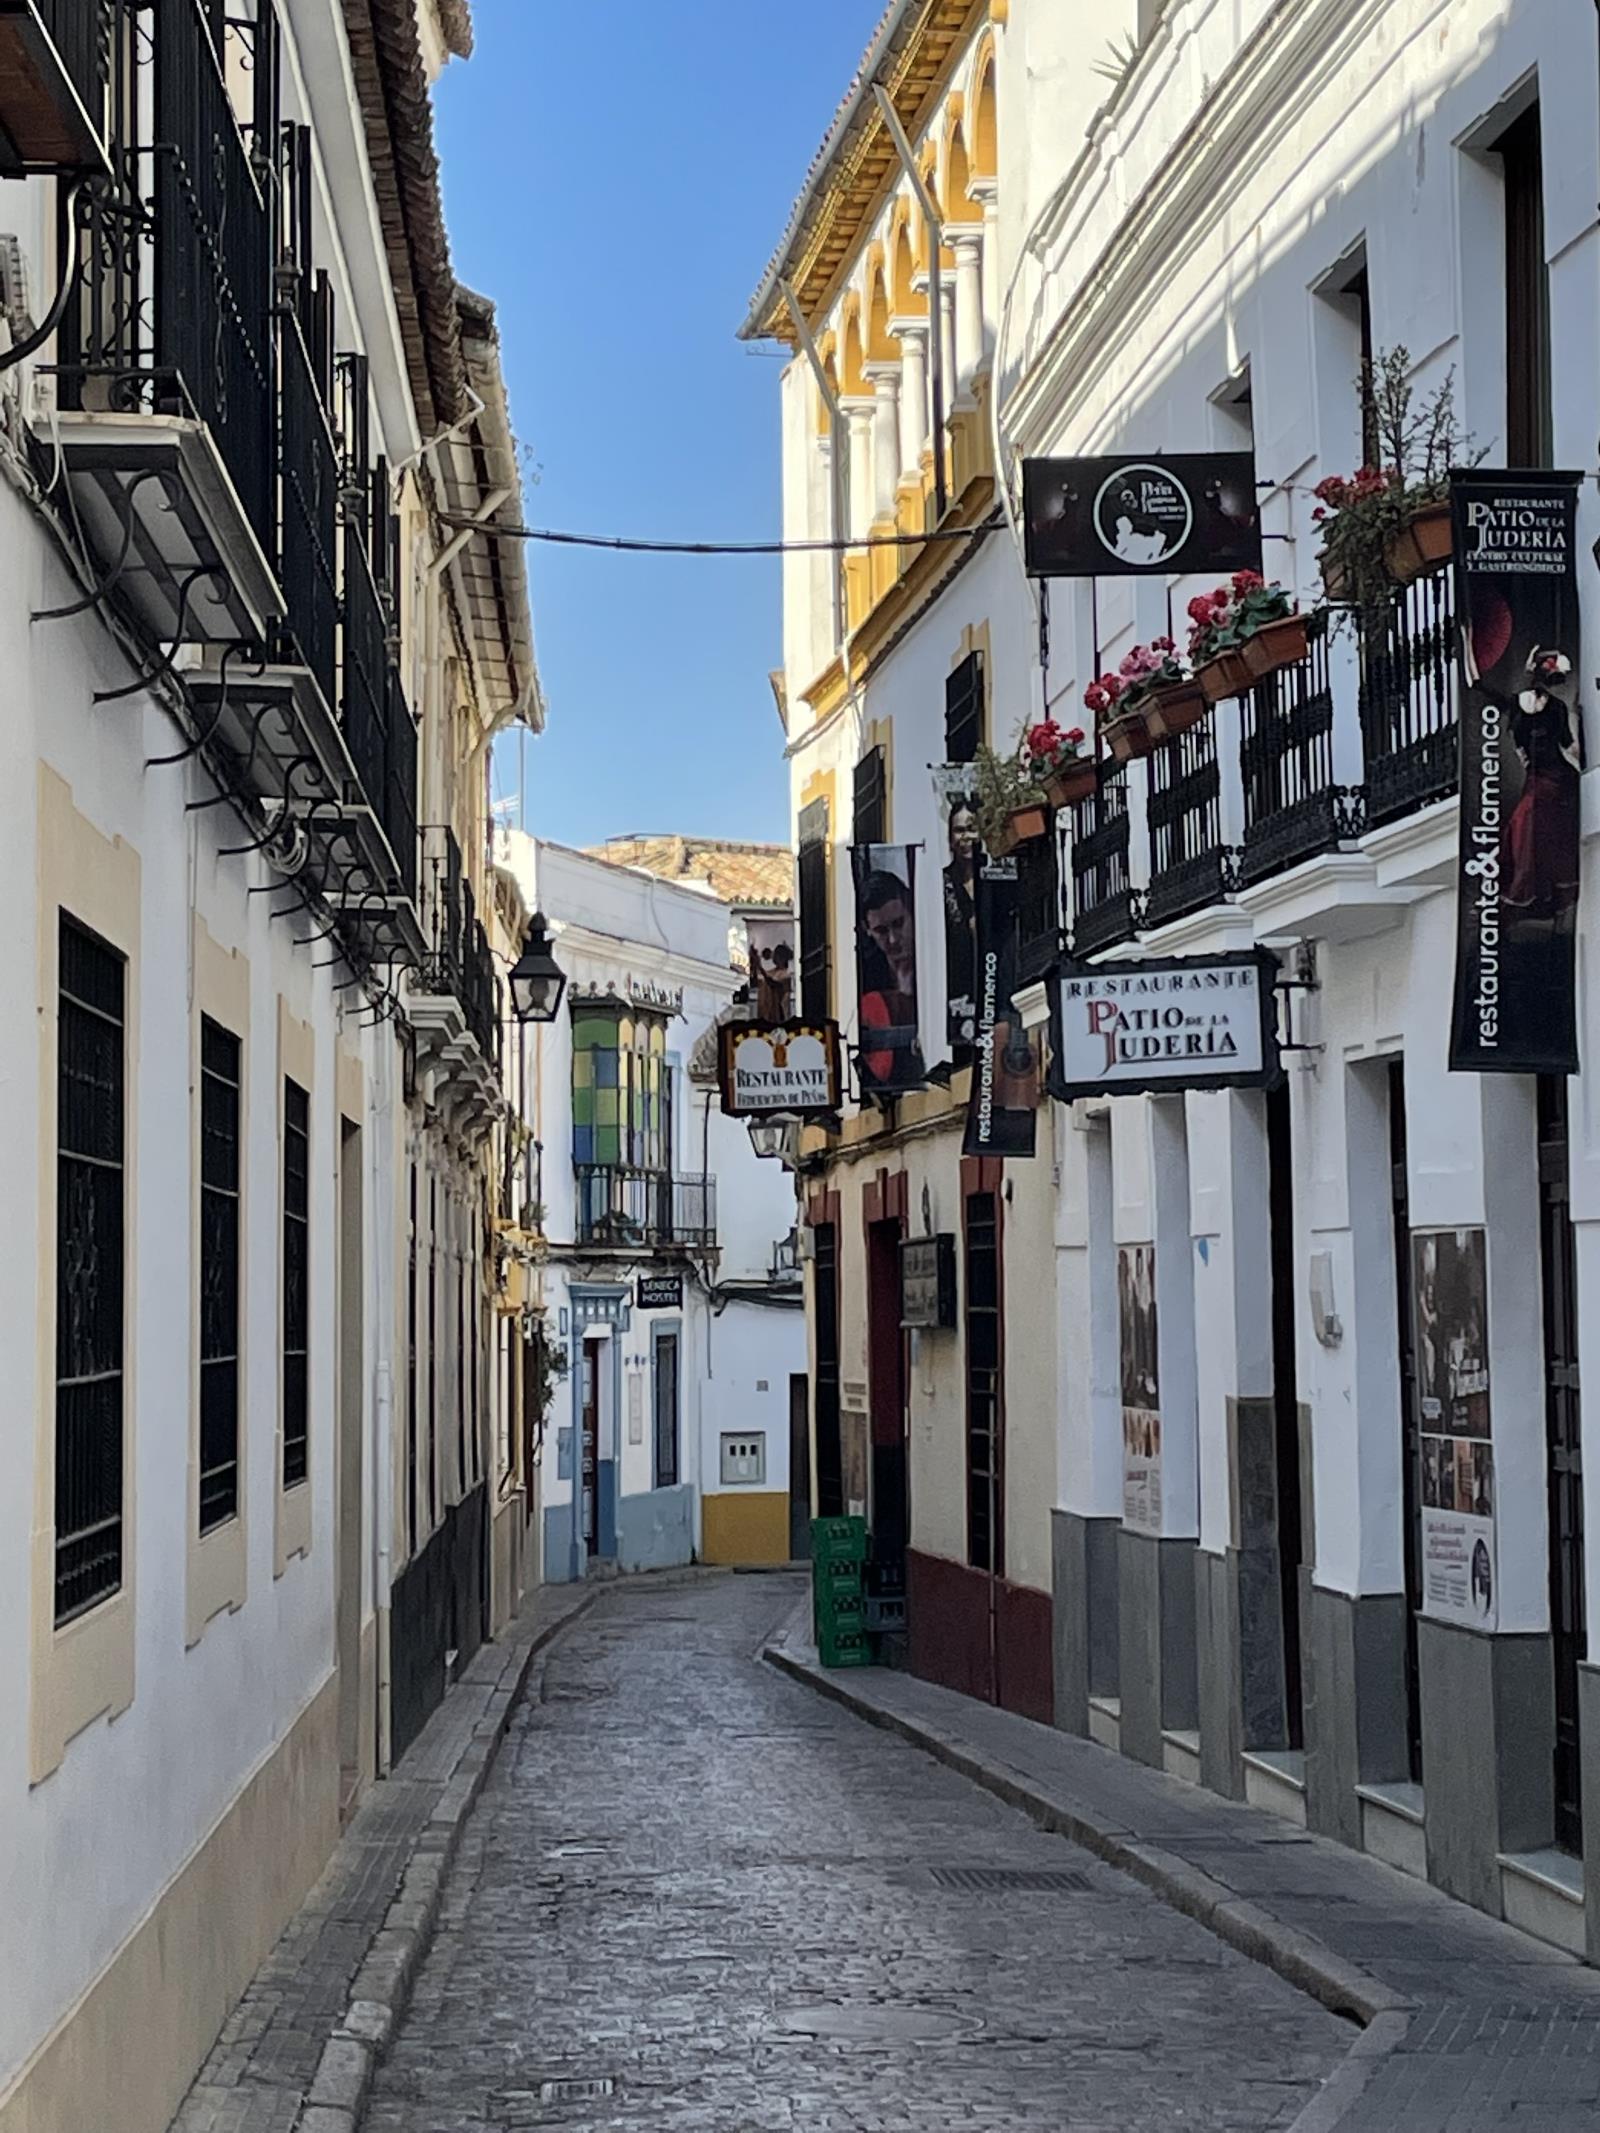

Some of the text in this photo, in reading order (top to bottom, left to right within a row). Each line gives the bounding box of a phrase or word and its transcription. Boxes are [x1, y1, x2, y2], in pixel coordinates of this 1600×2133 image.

[1467, 502, 1535, 527] PATIO
[1474, 526, 1566, 555] JUDERÍA
[1464, 704, 1500, 1047] restaurante&flamenco
[1067, 970, 1254, 999] RESTAURANTE
[1087, 1001, 1230, 1035] PATIO DE LA
[1098, 1025, 1237, 1077] JUDERÍA
[737, 1069, 827, 1088] RESTAURANTE
